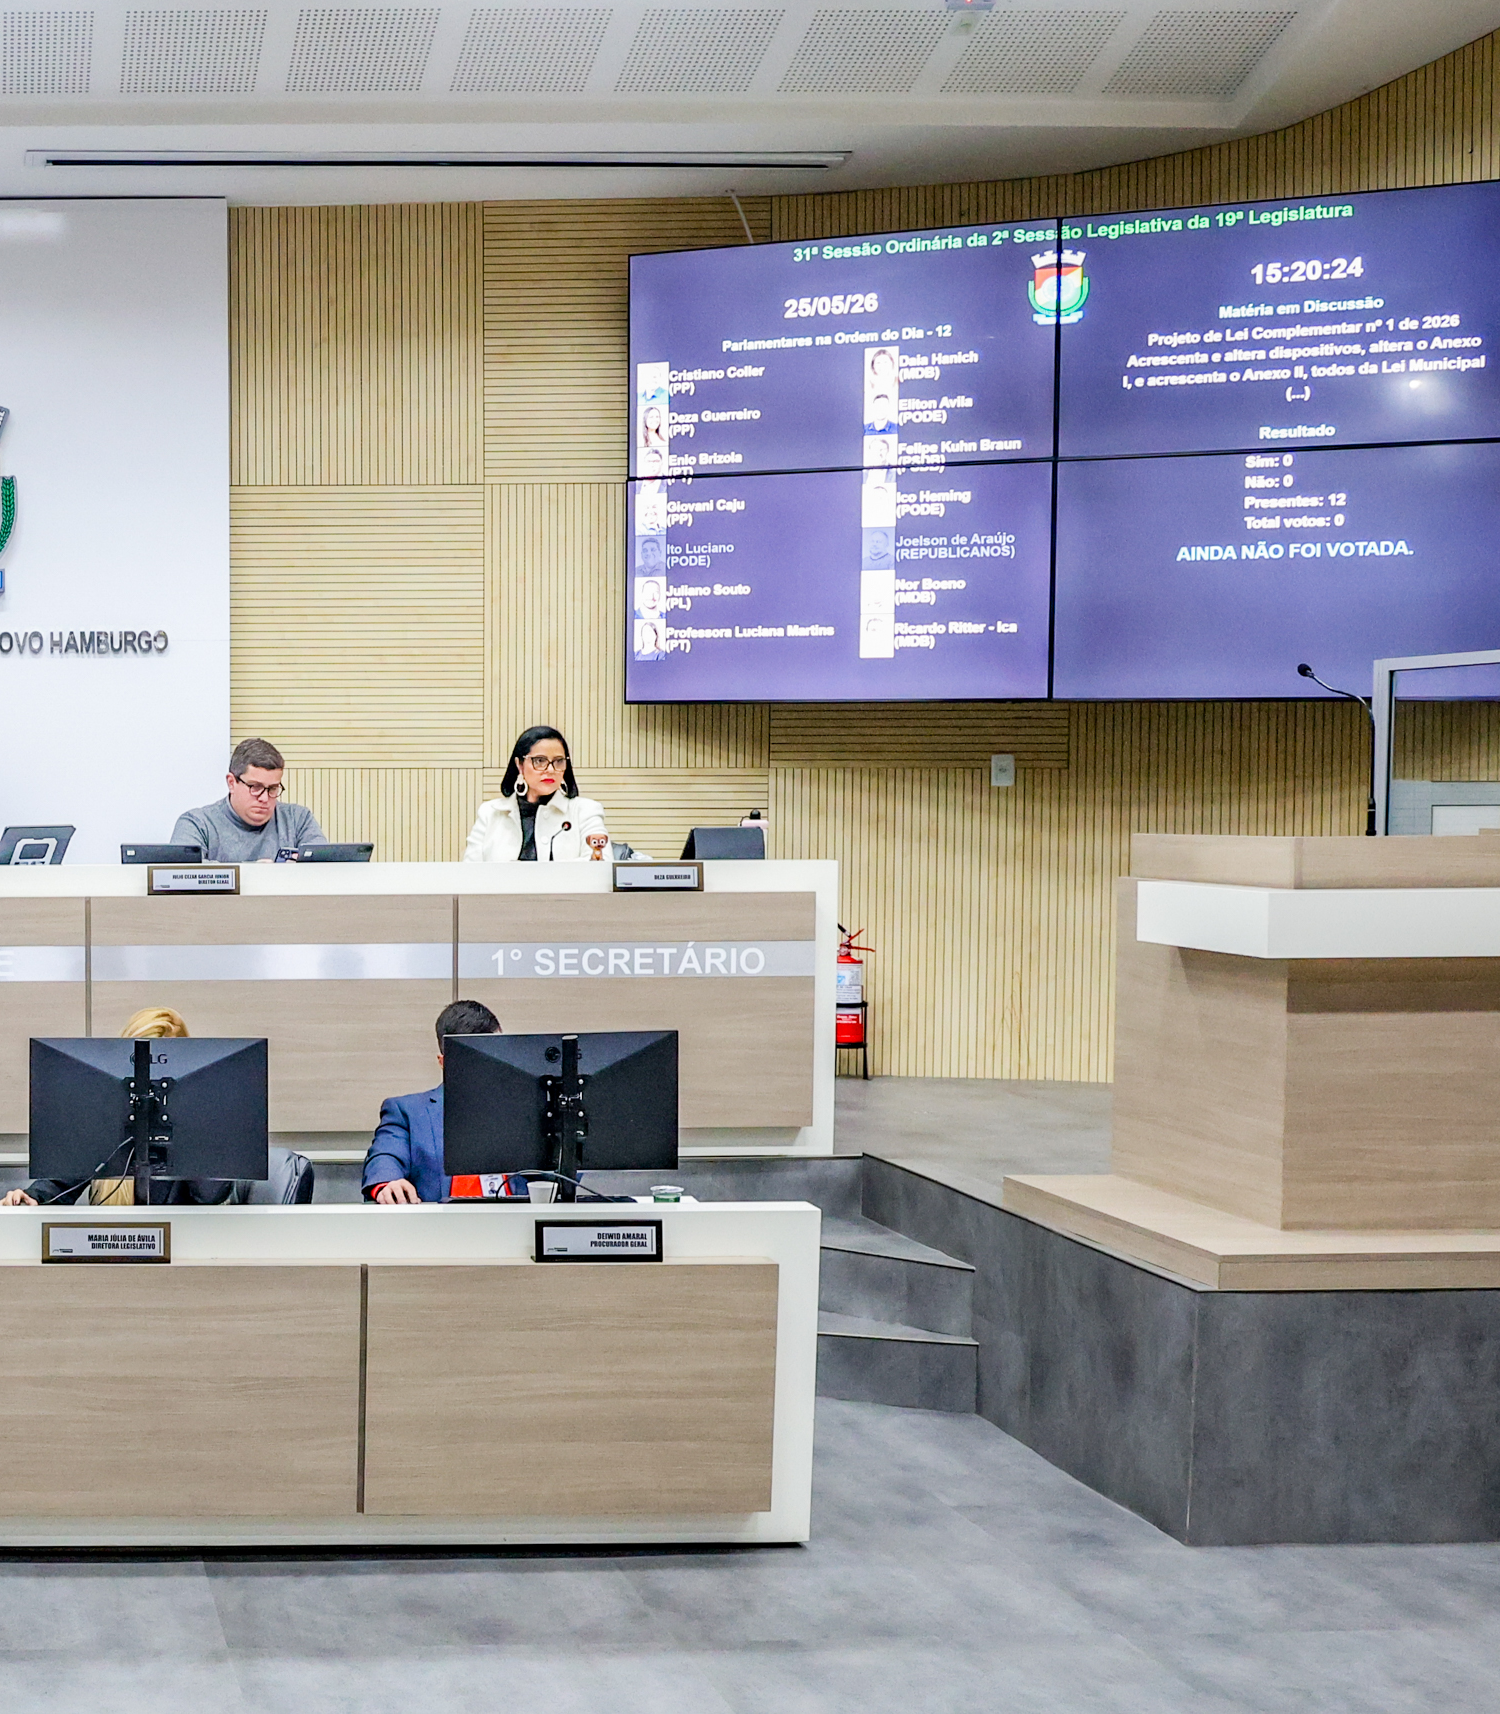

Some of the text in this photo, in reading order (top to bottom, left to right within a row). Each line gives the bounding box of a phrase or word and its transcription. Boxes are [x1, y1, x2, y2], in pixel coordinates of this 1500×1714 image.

[822, 242, 882, 260] Sessão
[886, 235, 962, 254] Ordinária
[967, 233, 987, 247] da
[991, 230, 1009, 246] 2ª
[1087, 215, 1182, 240] Legislativa
[1187, 214, 1209, 230] da
[1215, 211, 1244, 228] 19ª
[1249, 204, 1353, 227] Legislatura
[1251, 257, 1363, 284] 15:20:24
[784, 293, 879, 318] 25/05/26
[1219, 297, 1384, 319] Matéria em Discussão
[722, 324, 951, 352] Parlamentares na Ordem do Dia 12
[1148, 332, 1200, 347] Projeto
[1203, 330, 1222, 343] de
[1225, 327, 1248, 342] Lei
[1251, 320, 1362, 340] Complementar
[1386, 319, 1394, 331] 1
[1399, 317, 1418, 330] de
[1422, 314, 1460, 329] 2026
[931, 350, 979, 365] Hanich
[1126, 335, 1481, 368] Acrescenta e altera dispositivos, altera o Anexo
[669, 365, 765, 381] Cristiano Coller
[899, 366, 940, 382] (MDB)
[1135, 355, 1486, 387] e acrescenta o Anexo todos da Lei Municipal
[669, 381, 695, 397] (PP)
[669, 408, 761, 424] Deza Guerreiro
[898, 409, 947, 426] (PODE)
[669, 424, 695, 438] (PP)
[1259, 425, 1335, 440] Resultado
[898, 438, 1022, 457] Felipe Kuhn Braun
[668, 452, 743, 466] Enio Brizola
[1245, 454, 1293, 468] Sim: 0
[667, 467, 694, 486] (PT)
[1244, 475, 1293, 489] Não: 0
[919, 489, 971, 504] Heming
[1244, 494, 1346, 509] Presentes: 12
[667, 498, 746, 513] Giovani Caju
[896, 503, 946, 519] (PODE)
[667, 513, 693, 528] (PP)
[1244, 514, 1344, 529] Total votos: 0
[895, 532, 1016, 547] Joelson de Araújo
[666, 542, 735, 555] Ito Luciano
[895, 545, 1016, 562] (REPUBLICANOS)
[1177, 540, 1414, 562] AINDA NÃO FOI VOTADA.
[666, 555, 711, 569] (PODE)
[665, 583, 752, 597] Juliano Souto
[895, 578, 967, 591] Nor Boeno
[666, 597, 692, 611] (PL)
[895, 591, 936, 606] (MDB)
[665, 623, 836, 639] Professora Luciana Martins
[894, 620, 1018, 634] Ricardo Ritter Ica
[49, 630, 169, 656] HAMBURGO
[665, 639, 691, 654] (PT)
[894, 635, 936, 650] (MDB)
[534, 941, 765, 976] SECRETÁRIO
[110, 1234, 126, 1242] JÚLIA
[137, 1234, 155, 1242] ÁVILA
